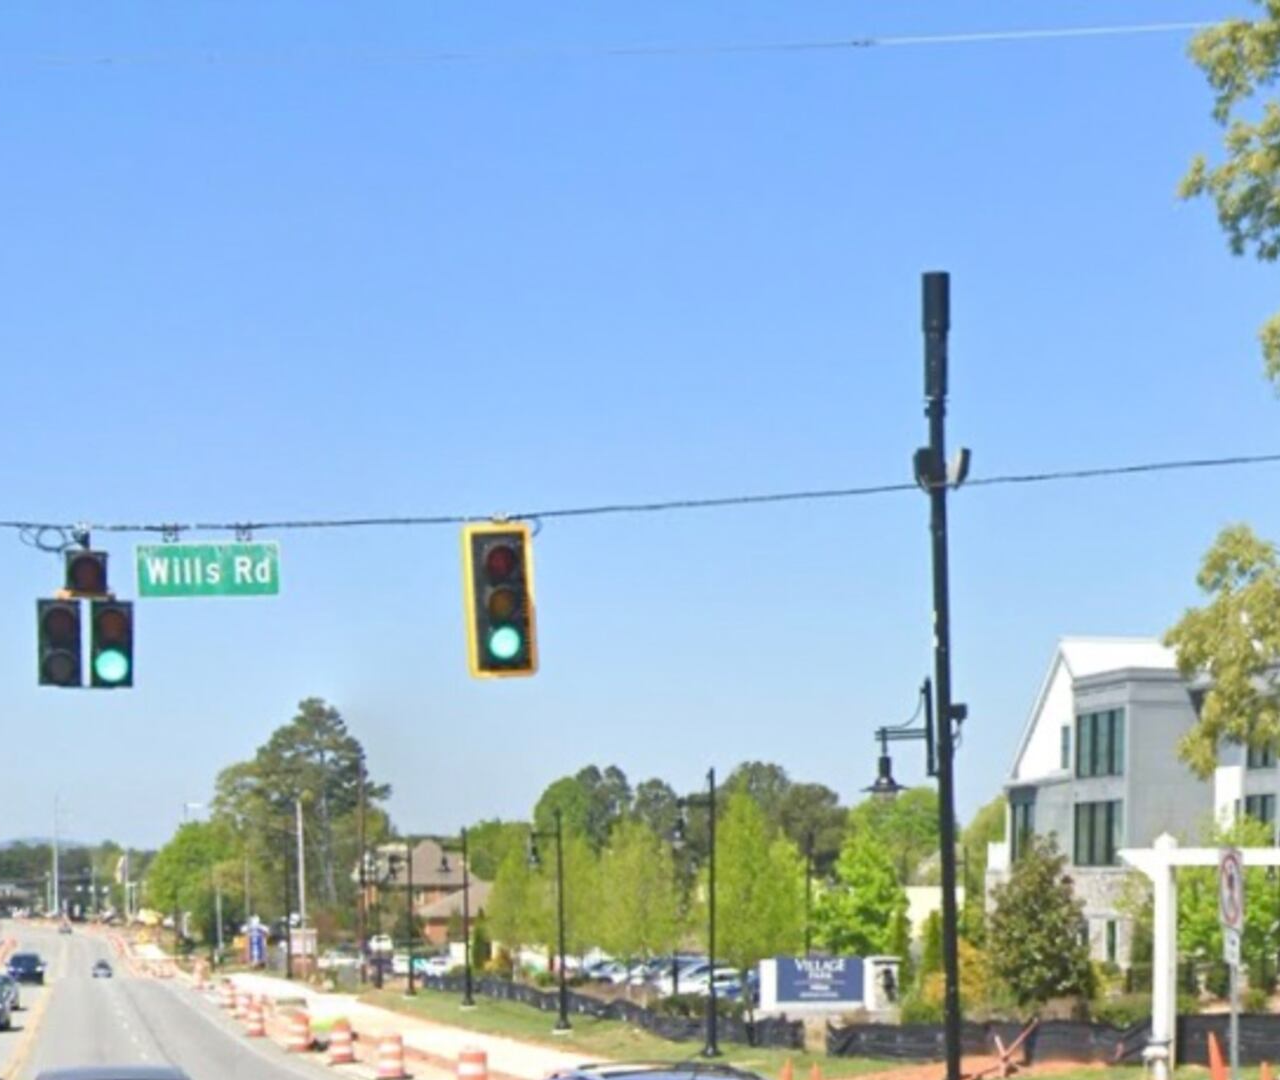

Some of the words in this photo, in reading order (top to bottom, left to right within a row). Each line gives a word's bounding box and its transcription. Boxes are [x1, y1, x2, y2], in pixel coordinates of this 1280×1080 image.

[147, 556, 221, 585] Wills
[233, 555, 271, 585] Rd
[794, 958, 845, 971] VILLAGE
